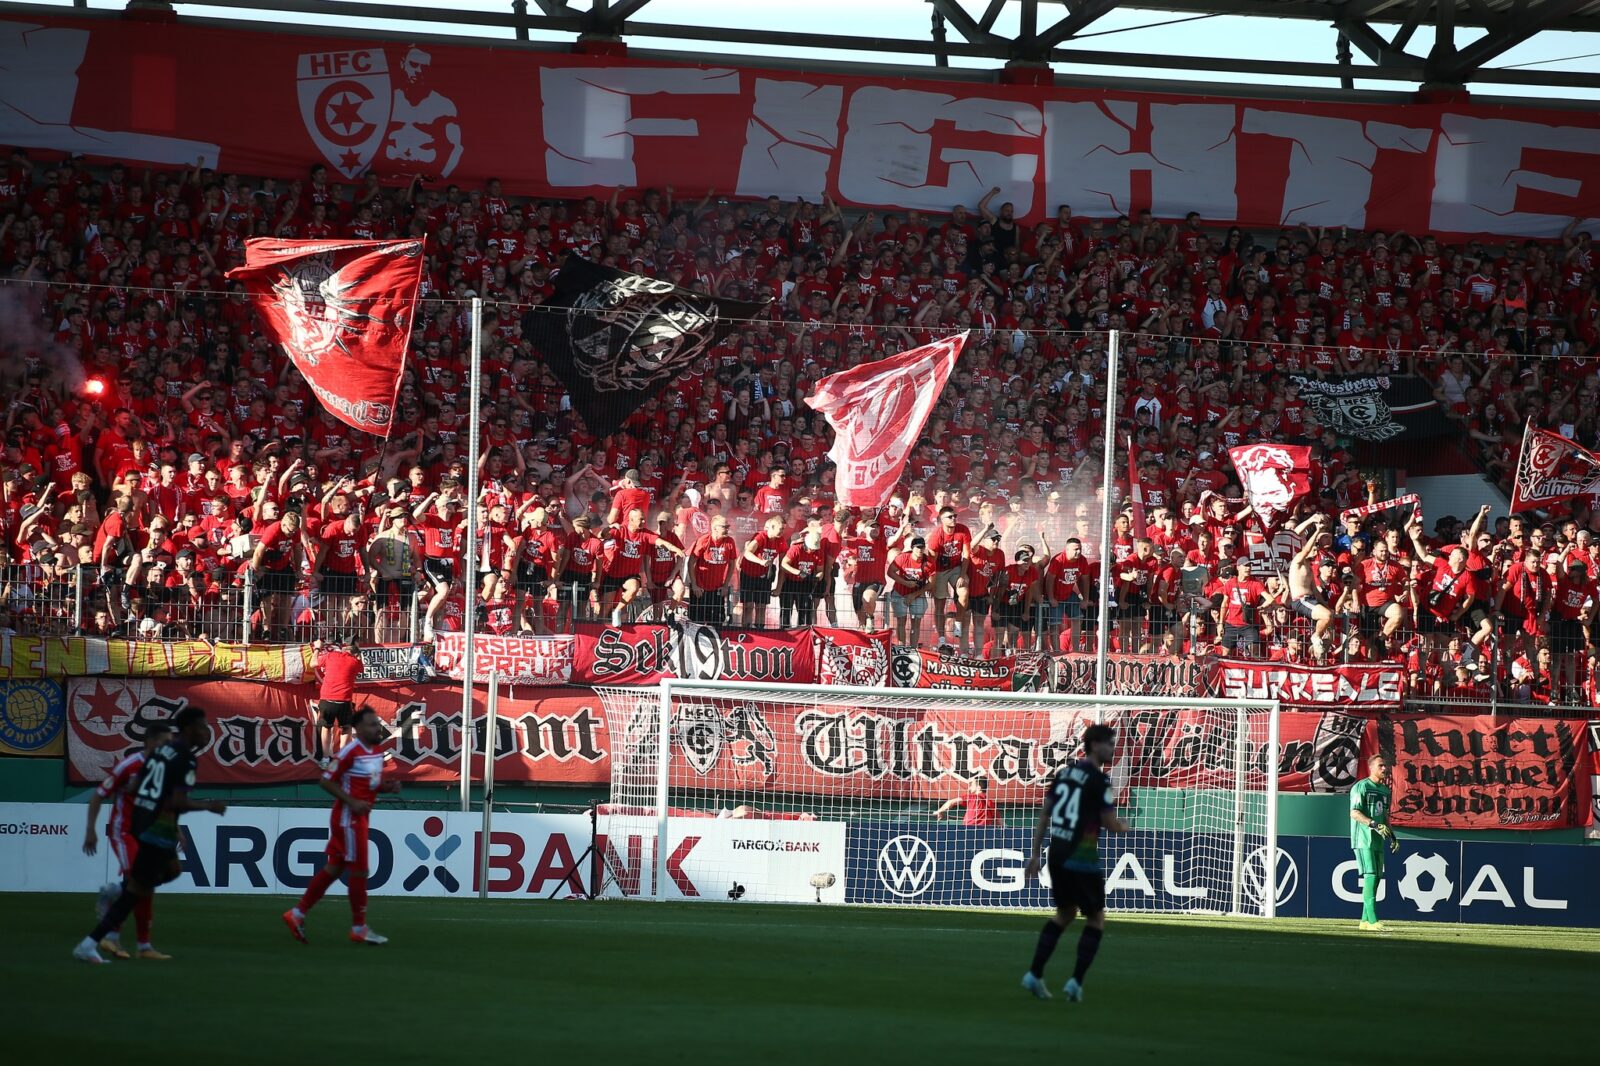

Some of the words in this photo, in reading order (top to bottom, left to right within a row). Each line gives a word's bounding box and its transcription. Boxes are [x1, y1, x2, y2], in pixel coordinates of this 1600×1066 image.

[310, 50, 372, 74] HFC
[926, 660, 1009, 678] MANSFELD
[138, 758, 165, 799] 29
[1051, 783, 1082, 829] 24
